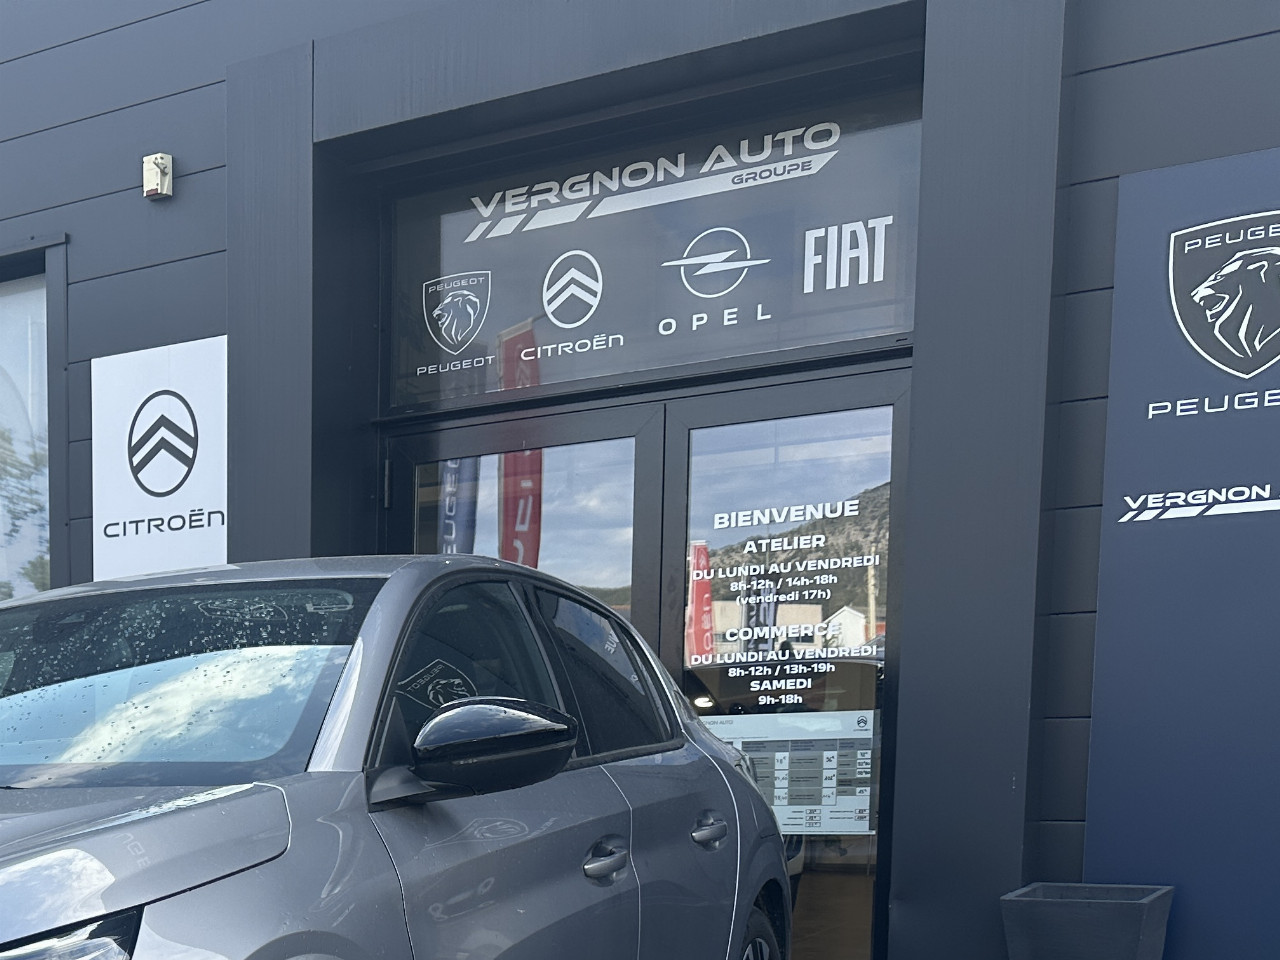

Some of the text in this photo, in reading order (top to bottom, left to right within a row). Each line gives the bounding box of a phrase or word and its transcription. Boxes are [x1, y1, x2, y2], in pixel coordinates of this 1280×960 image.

[470, 121, 842, 219] VERGNON AUTO
[730, 160, 814, 186] GROUPE
[802, 215, 894, 294] FIAT
[428, 277, 485, 294] PEUGEOT
[658, 303, 772, 336] OPEL
[416, 355, 496, 376] PEUGEOT
[1123, 484, 1272, 510] VERGNON
[713, 499, 860, 530] BIENVENUE
[743, 534, 826, 554] ATELIER
[692, 554, 880, 581] DU LUNDI AU VENDREDI
[730, 579, 774, 592] 8h-12h
[785, 574, 838, 587] 14h-18h
[736, 588, 831, 606] (vendredi 17h)
[725, 621, 842, 642] COMMERCE
[691, 645, 878, 665] DU LUNDI AU VENDREDI
[727, 666, 772, 678] 8h-12h
[783, 662, 836, 675] 13h-19h
[750, 678, 812, 691] SAMEDI
[758, 694, 803, 705] 9h-18h
